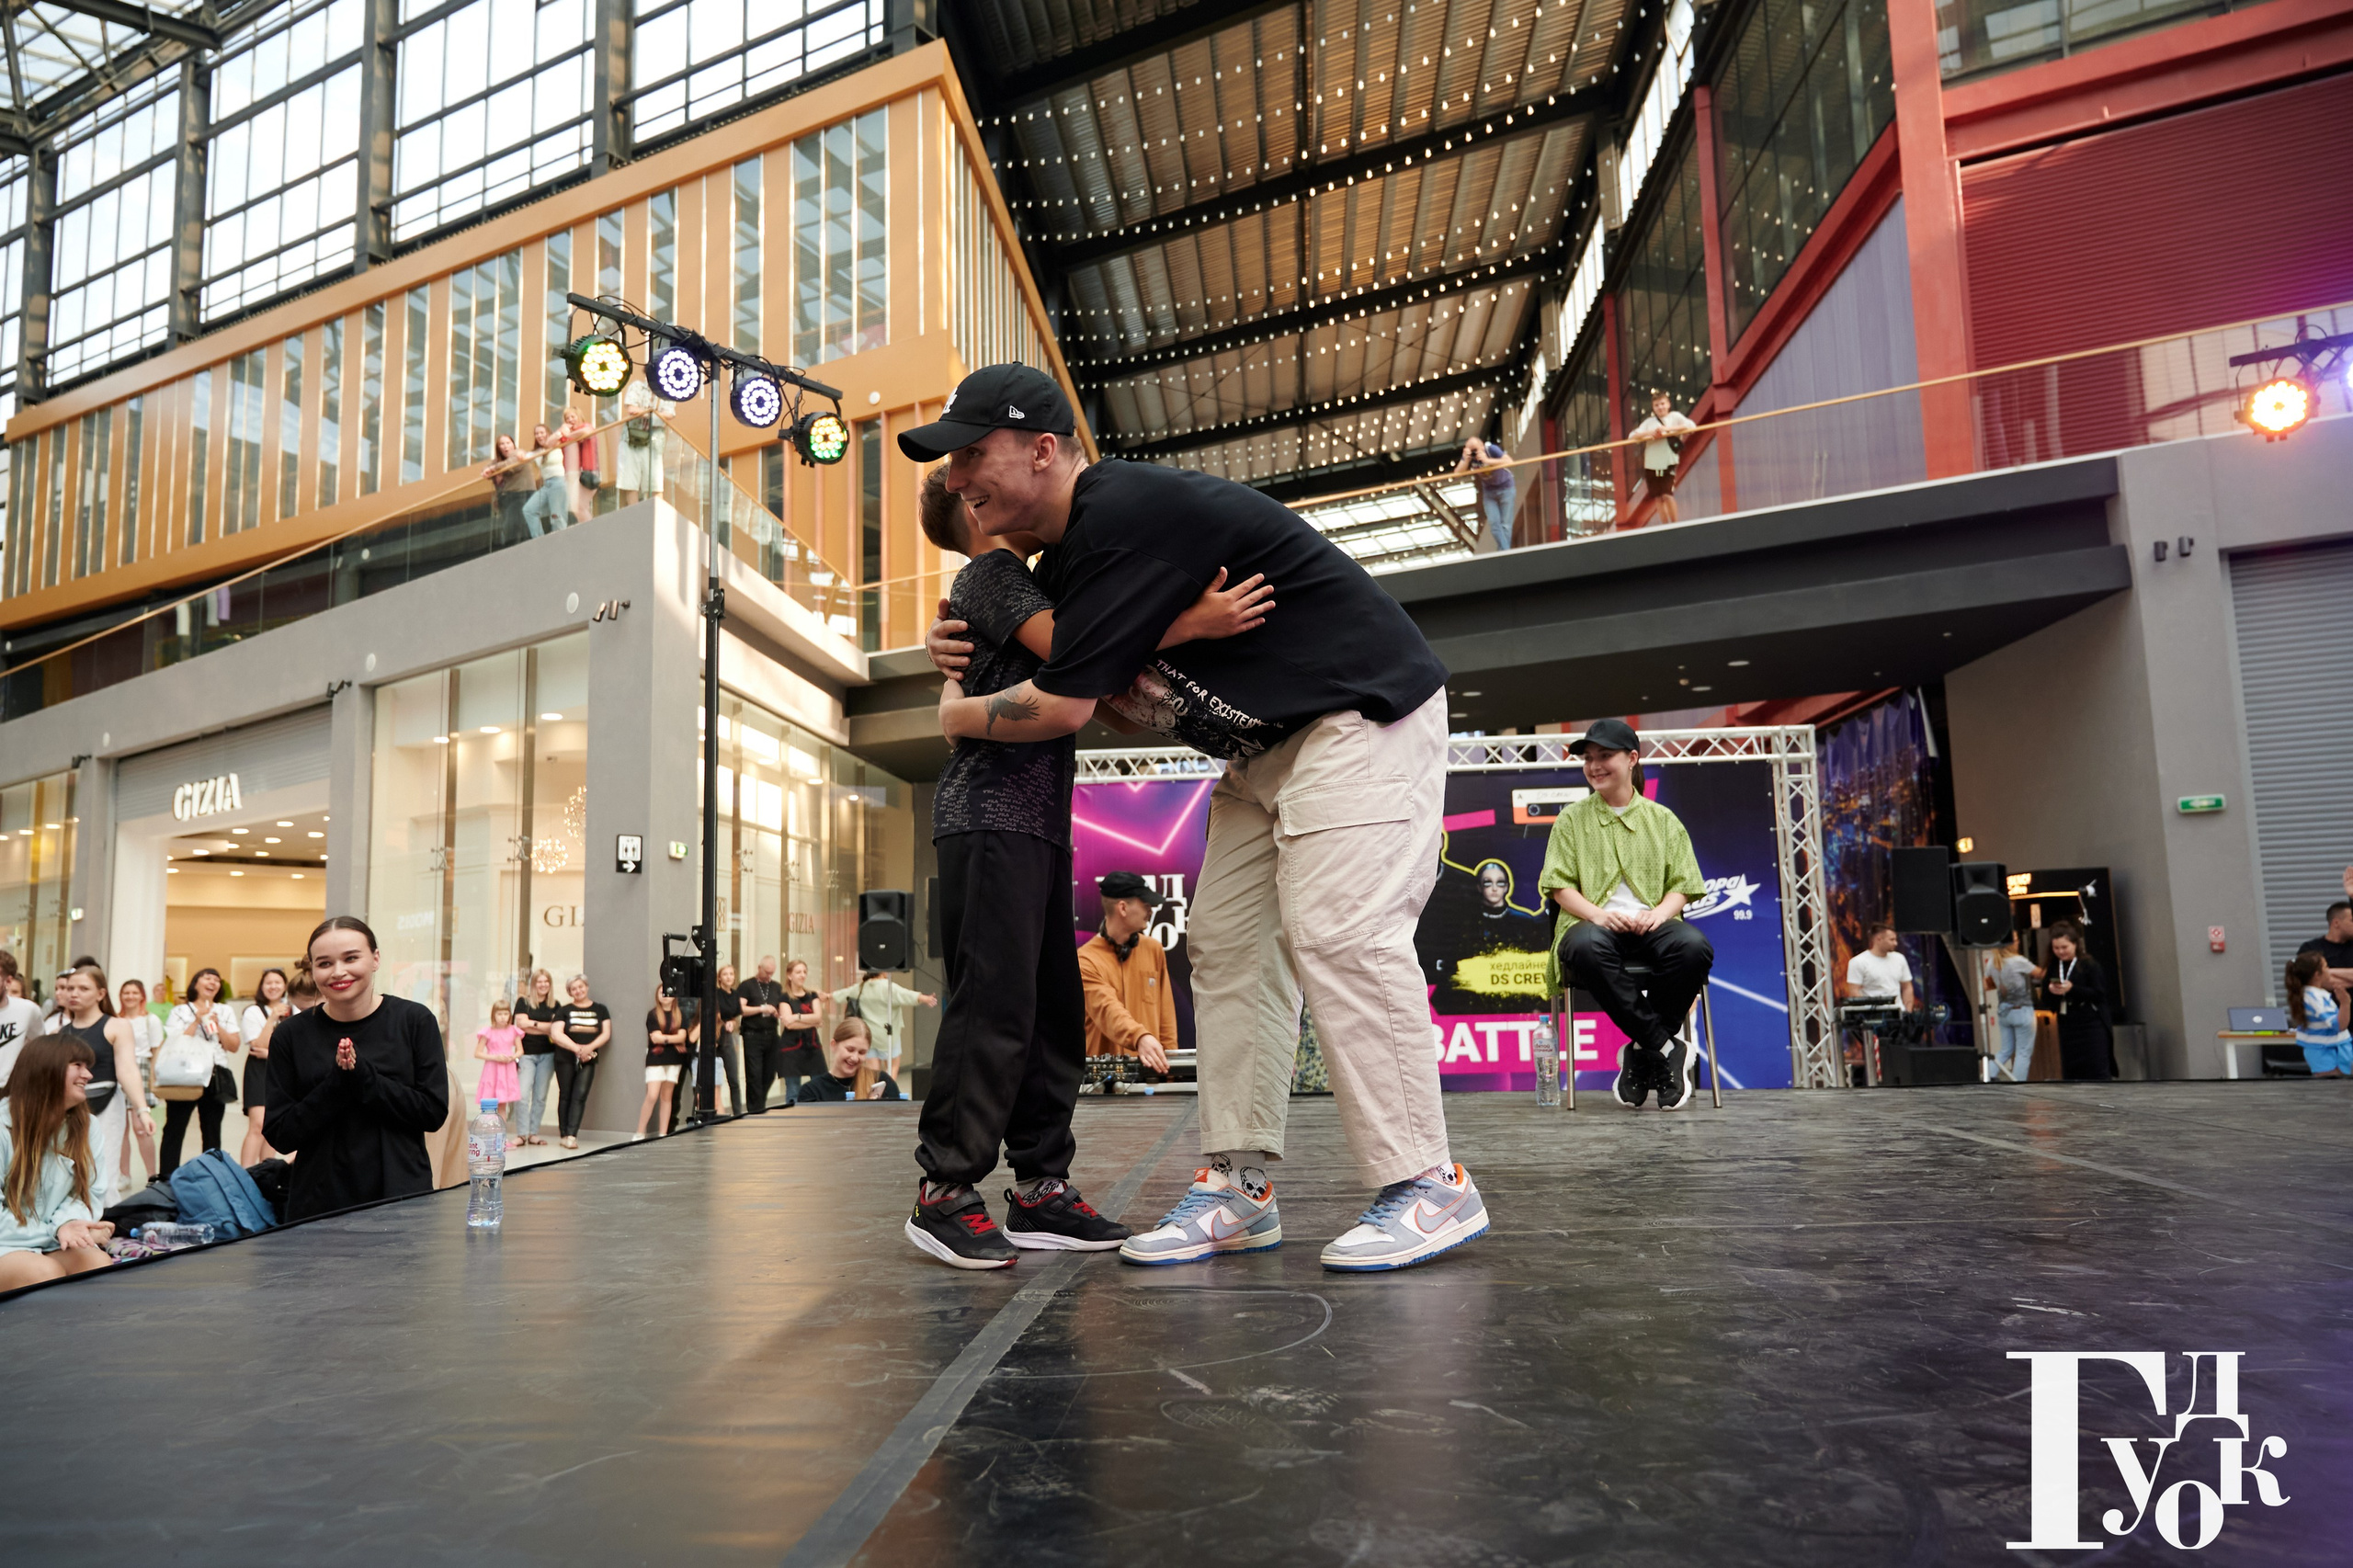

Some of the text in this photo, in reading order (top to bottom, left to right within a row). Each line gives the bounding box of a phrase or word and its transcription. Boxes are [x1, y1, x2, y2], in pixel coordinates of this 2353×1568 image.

[1156, 659, 1187, 681] THAT
[1186, 680, 1209, 702] FOR
[173, 772, 243, 822] GIZIA
[543, 904, 585, 927] GI
[790, 912, 814, 935] GIZIA
[1733, 909, 1753, 920] 99.9
[1490, 960, 1546, 971] хедлайне
[1491, 973, 1509, 985] DS
[0, 1022, 17, 1040] KE
[1432, 1019, 1598, 1063] BATTE
